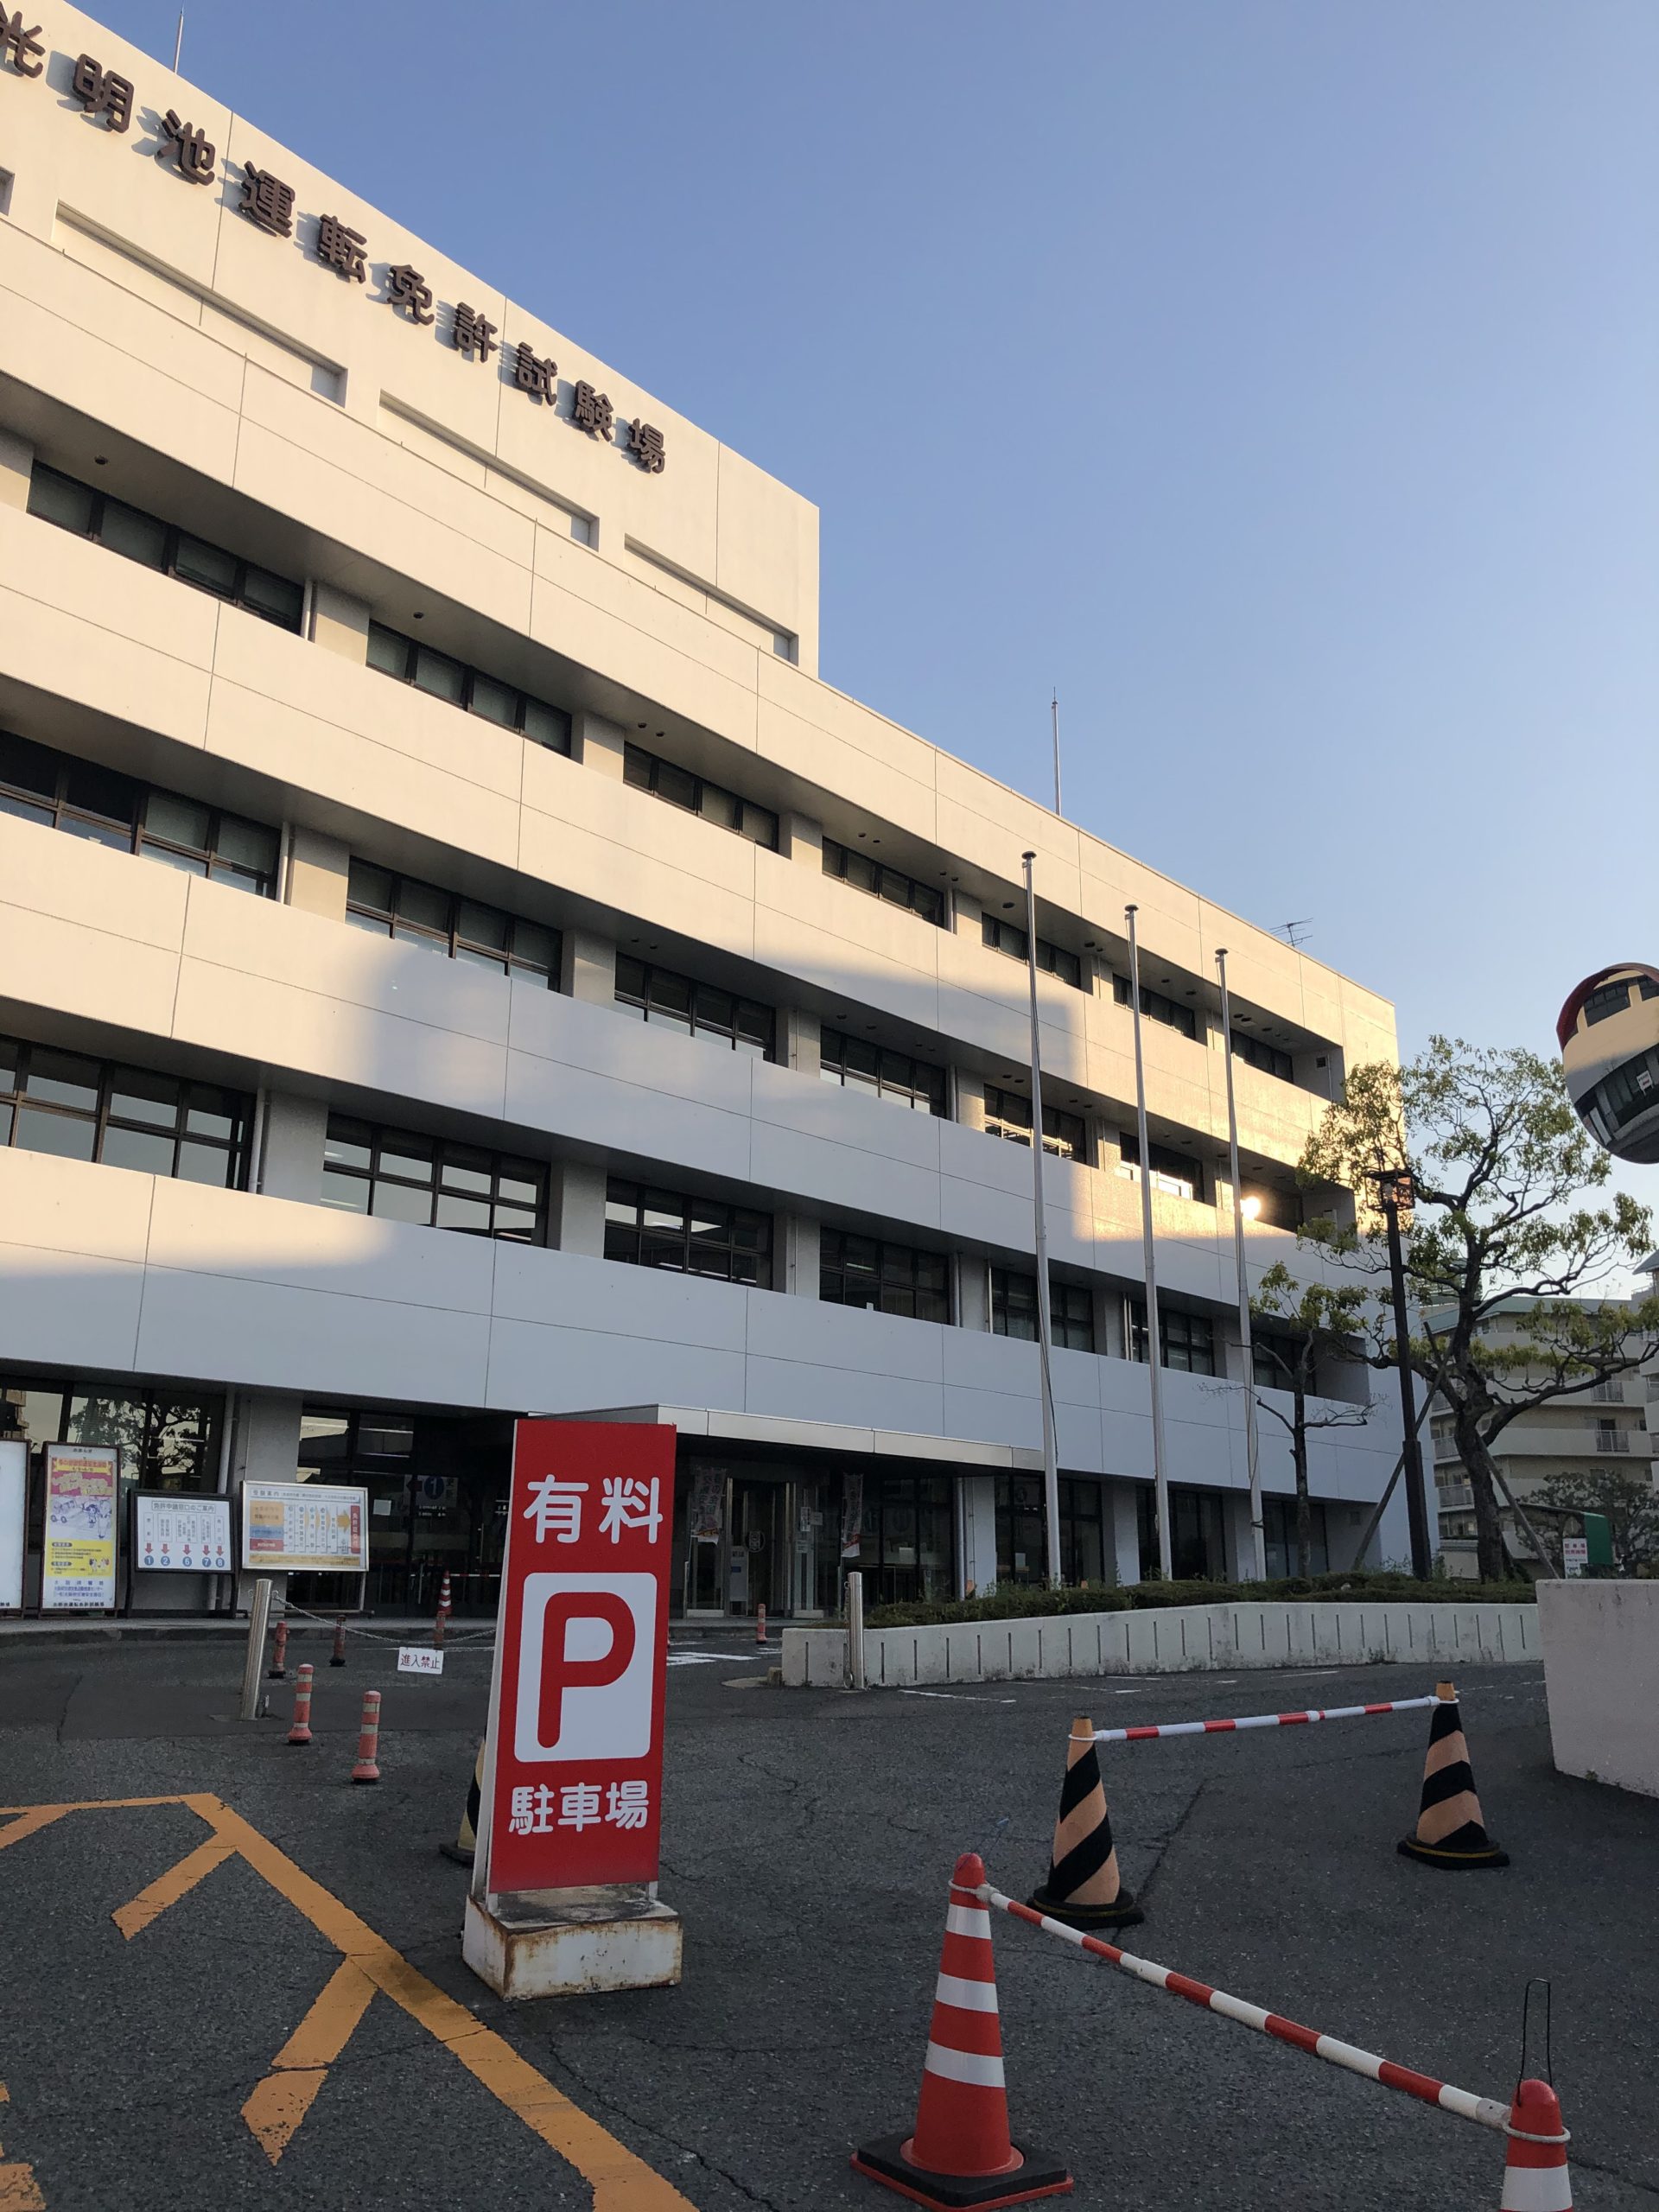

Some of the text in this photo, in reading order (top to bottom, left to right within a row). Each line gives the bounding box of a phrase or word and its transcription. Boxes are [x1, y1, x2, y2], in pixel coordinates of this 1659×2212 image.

[0, 7, 665, 474] 光明池運転免許試験場
[523, 1474, 663, 1544] 有料
[400, 1654, 441, 1669] 進入禁止
[537, 1592, 635, 1748] P
[508, 1780, 649, 1835] 駐車場
